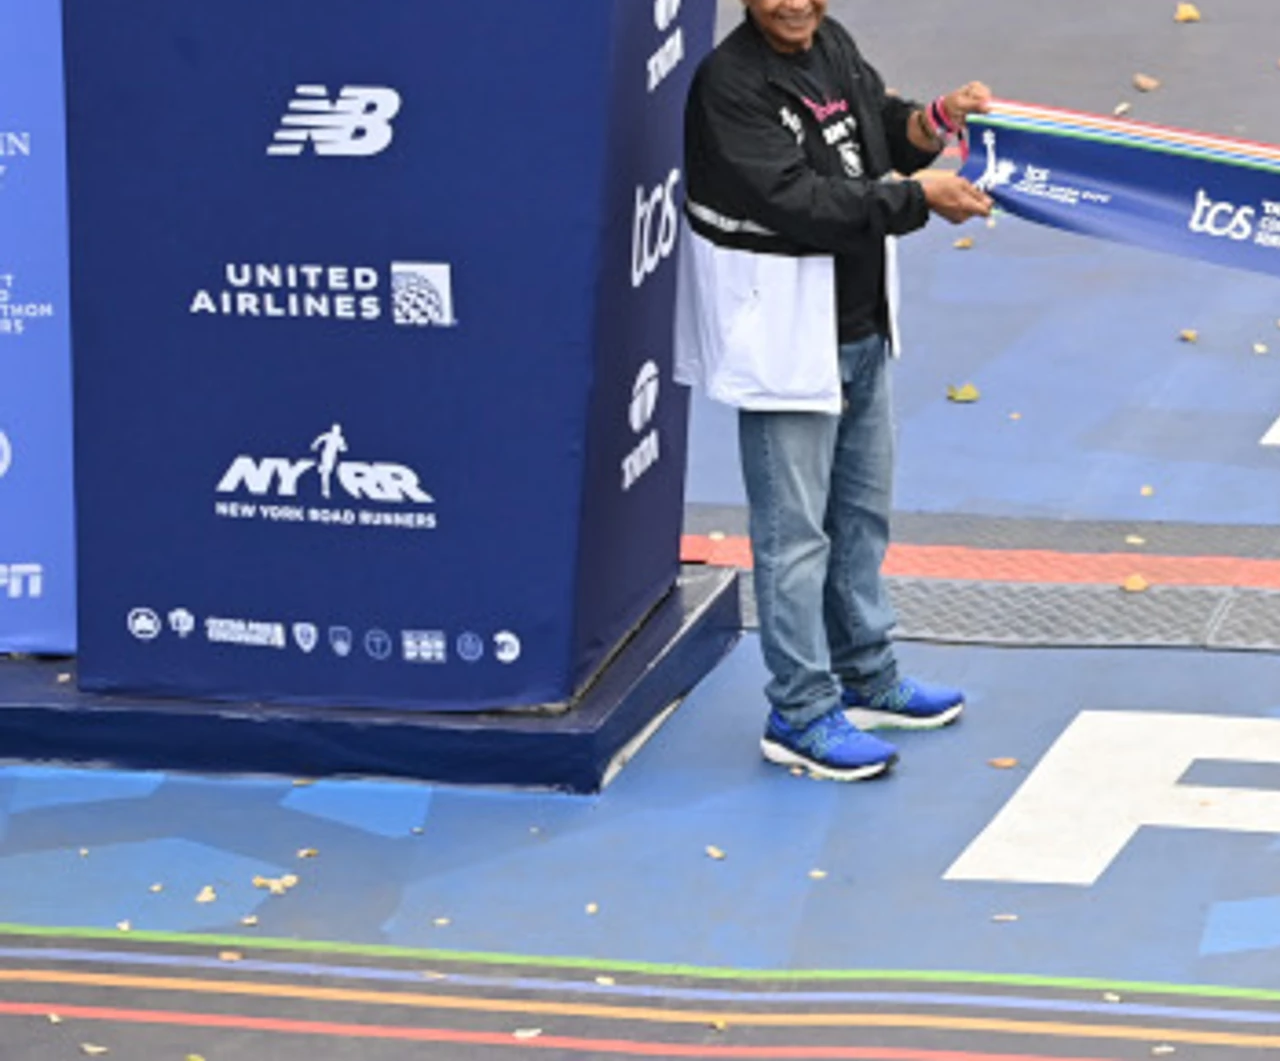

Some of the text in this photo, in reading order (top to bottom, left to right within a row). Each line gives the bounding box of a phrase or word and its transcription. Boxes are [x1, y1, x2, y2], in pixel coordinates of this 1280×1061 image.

[631, 167, 681, 287] tcs
[1189, 189, 1255, 240] tcs
[226, 263, 378, 290] UNITED
[190, 290, 381, 319] AIRLINES
[215, 445, 435, 504] NYRR
[215, 501, 437, 529] NEW YORK ROAD RUNNERS
